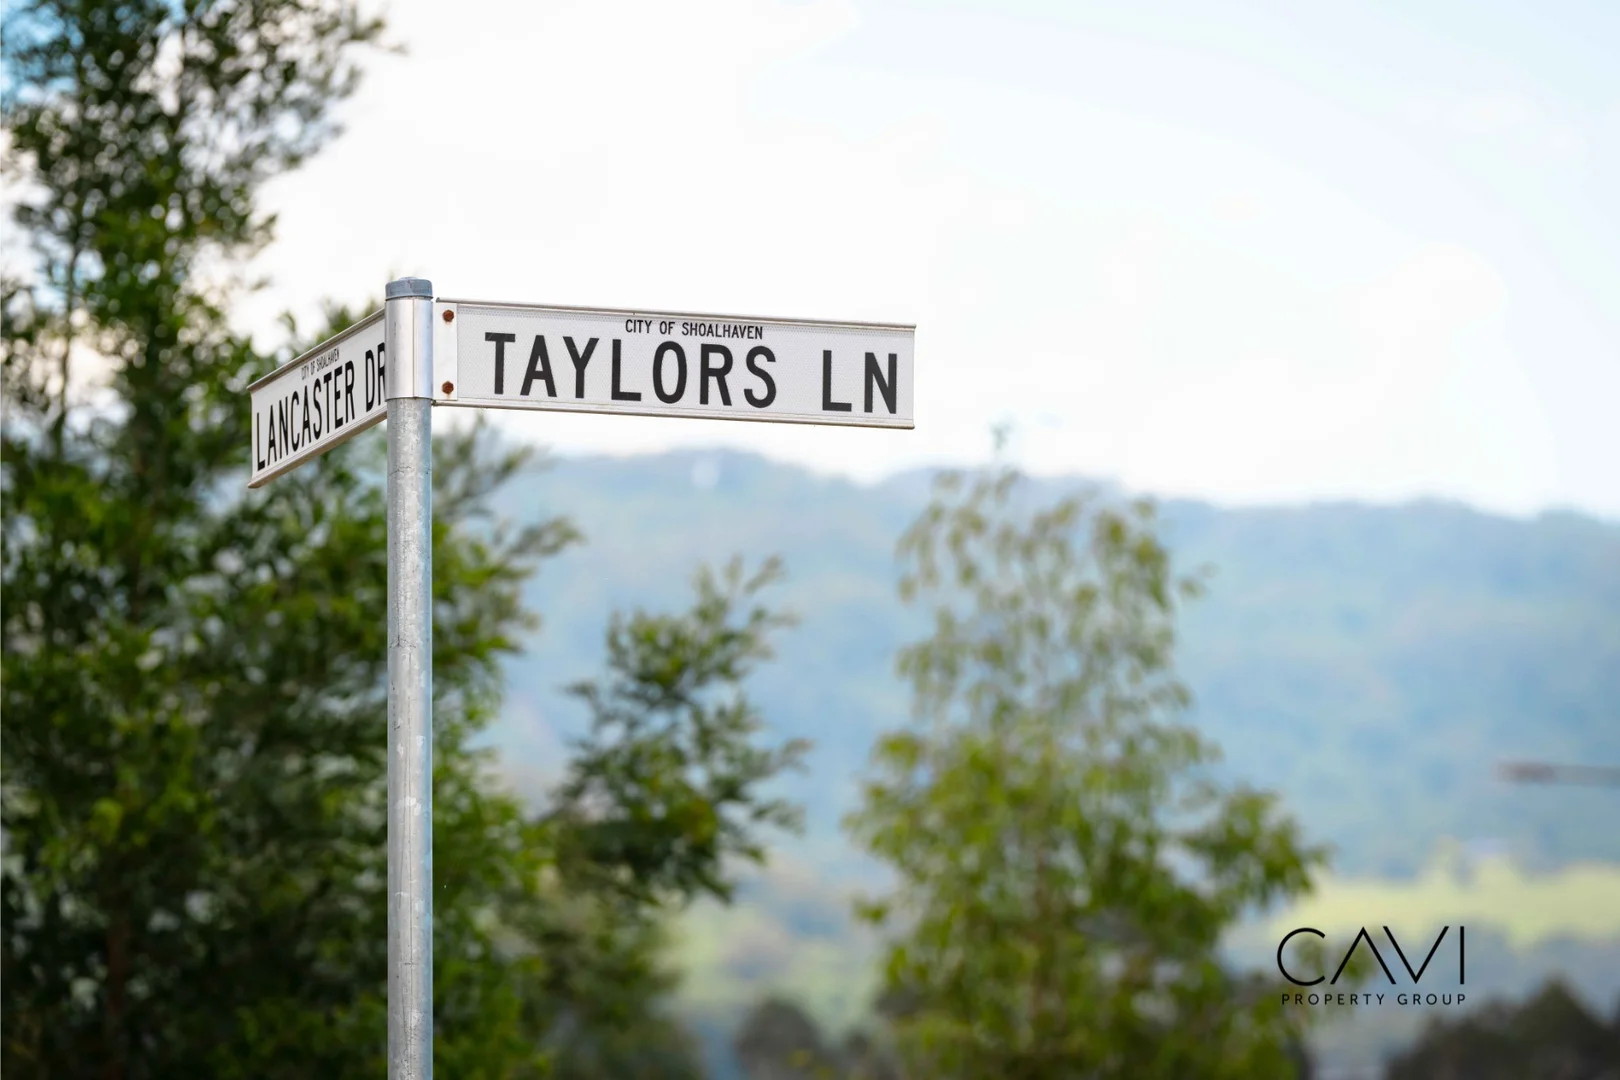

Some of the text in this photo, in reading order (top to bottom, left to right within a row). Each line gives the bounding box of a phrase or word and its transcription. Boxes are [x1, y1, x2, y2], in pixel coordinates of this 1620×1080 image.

[625, 319, 764, 340] CITY OF SHOALHAVEN
[301, 367, 310, 381] CITY
[316, 347, 340, 372] SHOALHAVEN
[485, 332, 898, 415] TAYLORS LN
[256, 342, 386, 472] LANCASTER DR
